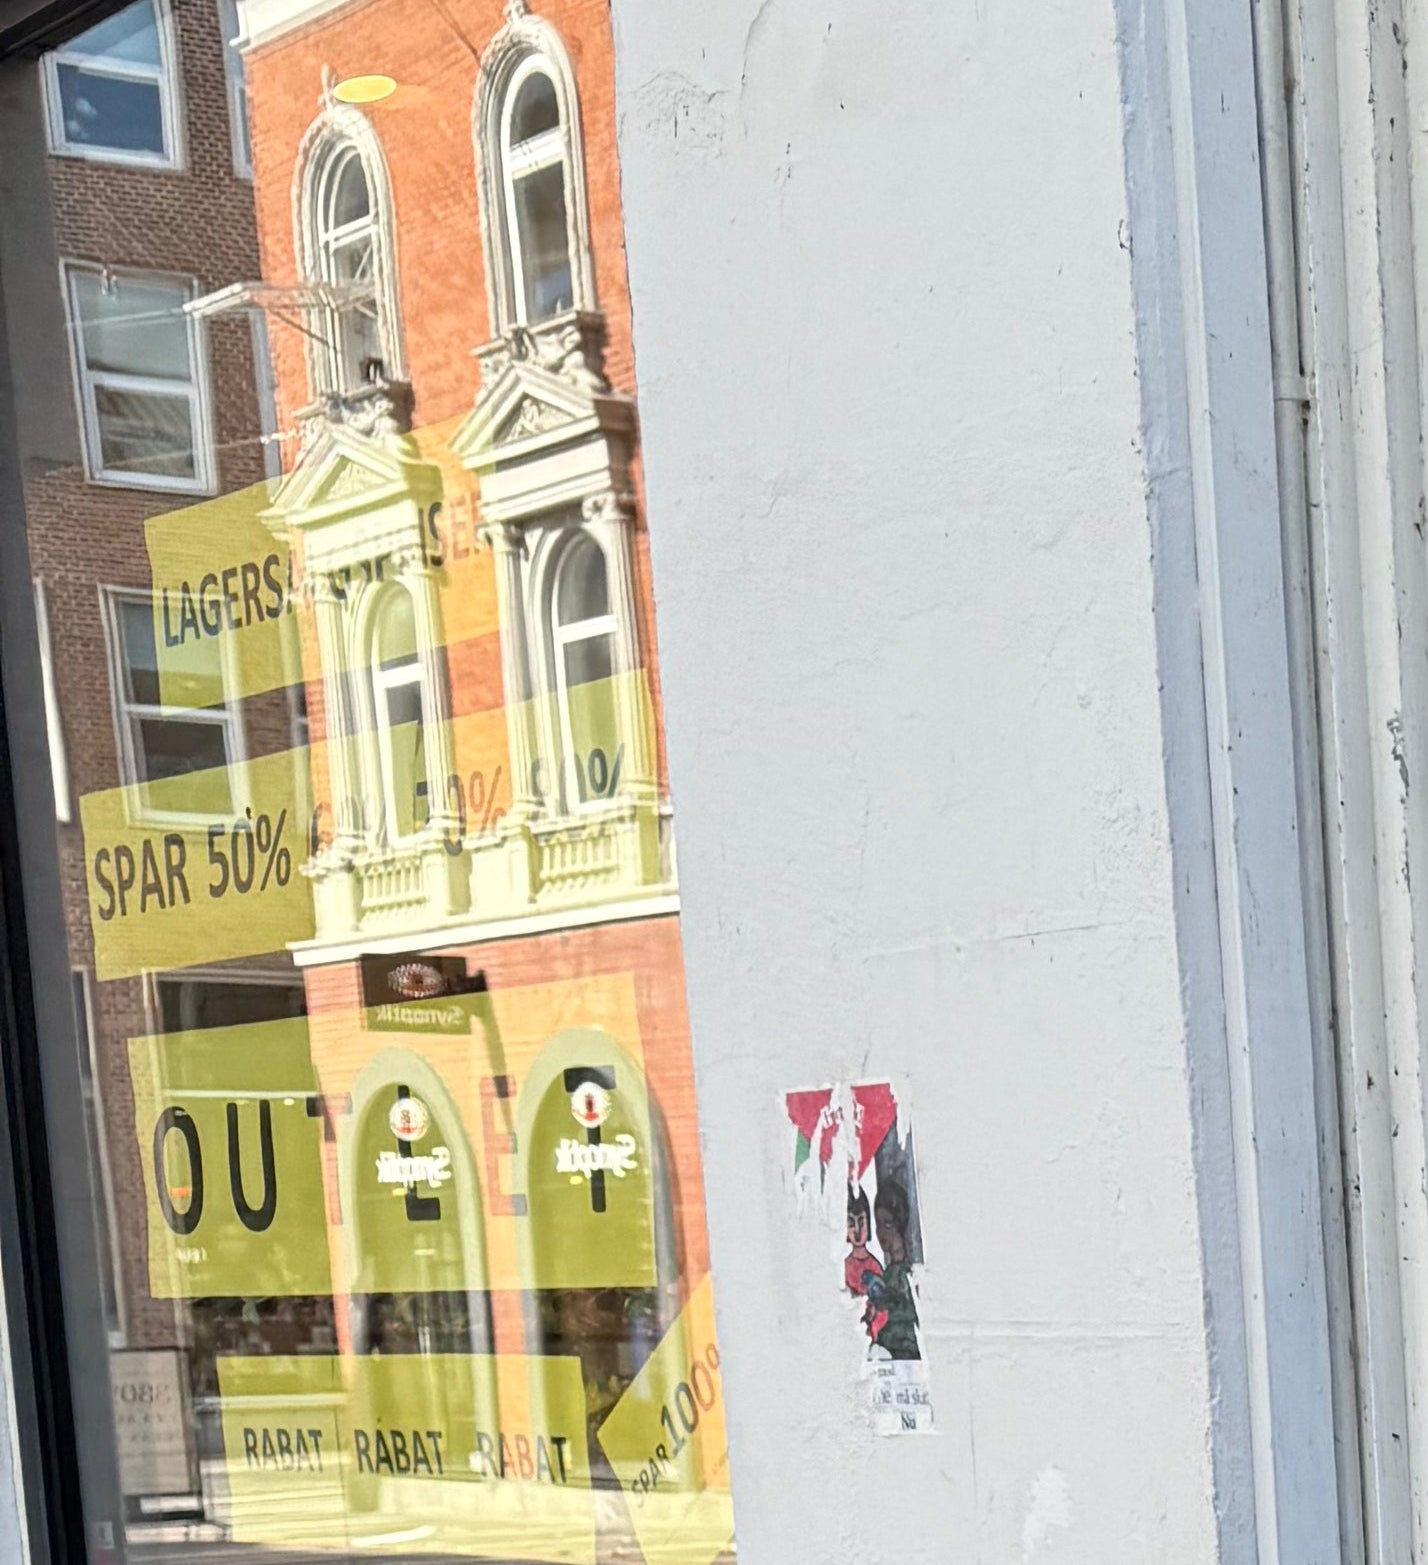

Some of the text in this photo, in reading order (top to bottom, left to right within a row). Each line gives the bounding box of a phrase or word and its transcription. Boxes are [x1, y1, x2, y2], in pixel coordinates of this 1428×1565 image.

[95, 833, 191, 921] SPAR
[208, 809, 291, 899] 50%
[242, 1427, 568, 1485] RABAT RABAT RABAT
[631, 1443, 671, 1508] SPAR
